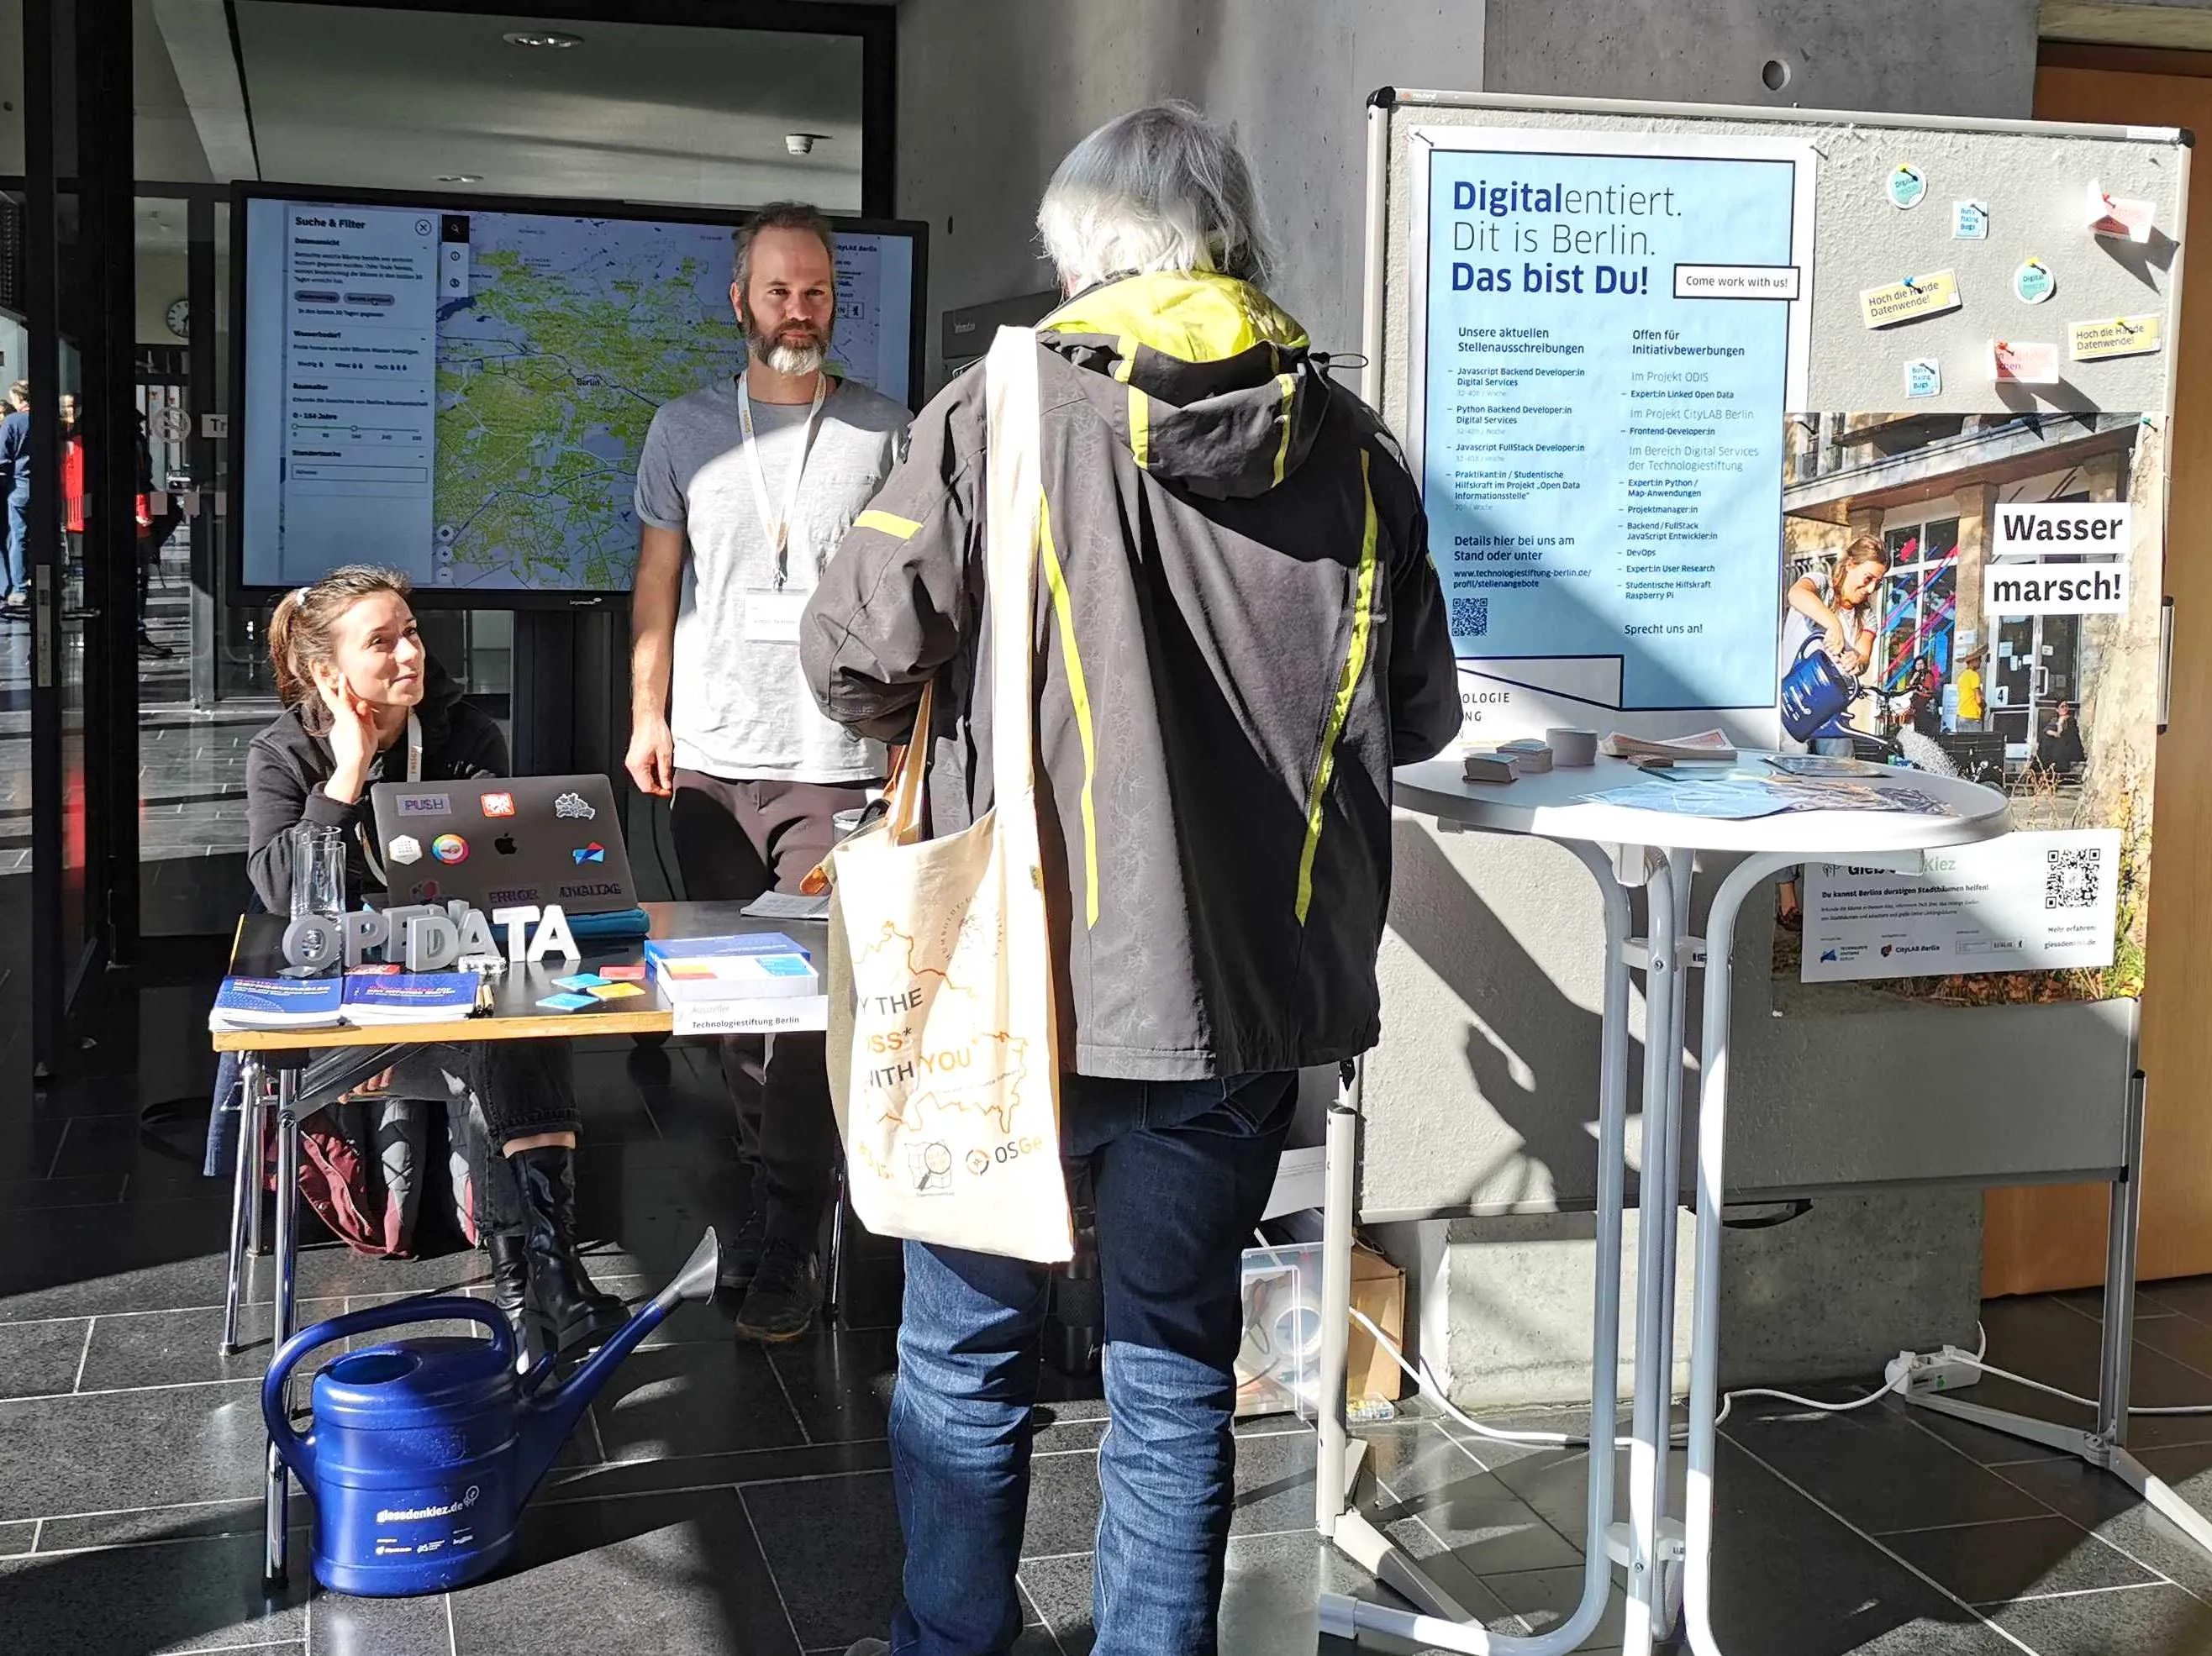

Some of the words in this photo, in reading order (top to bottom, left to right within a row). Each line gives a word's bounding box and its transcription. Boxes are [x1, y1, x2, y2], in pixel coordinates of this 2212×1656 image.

[1453, 179, 1682, 218] Digitalentiert.
[295, 216, 327, 228] Suche
[329, 218, 337, 228] &
[339, 218, 366, 229] Filter
[1454, 220, 1500, 252] Dit
[1514, 221, 1539, 253] is
[1553, 223, 1656, 255] Berlin.
[1451, 261, 1512, 292] Das
[1523, 261, 1585, 294] bist
[1595, 265, 1648, 295] Du!
[1686, 276, 1715, 287] Come
[1718, 276, 1745, 287] work
[1747, 276, 1771, 287] with
[1772, 277, 1788, 288] us!
[1868, 293, 1893, 307] Hoch
[1893, 290, 1908, 301] die
[1909, 282, 1940, 296] Hnde
[1870, 294, 1930, 318] Datenwende!
[1458, 327, 1497, 338] Unsere
[1498, 328, 1550, 339] aktuellen
[1632, 329, 1662, 340] Offen
[1664, 329, 1680, 340] für
[2076, 329, 2099, 339] Hoch
[2101, 328, 2114, 337] die
[1458, 341, 1585, 355] Stellenausschreibungen
[2077, 336, 2135, 351] Datenwende!
[1632, 344, 1746, 358] Initiativbewerbungen
[1456, 368, 1498, 377] Javascript
[1500, 368, 1534, 376] Backend
[1535, 369, 1585, 377] Developer:in
[1631, 372, 1644, 381] Im
[1646, 372, 1682, 383] Projekt
[1684, 372, 1709, 382] ODIS
[576, 377, 601, 386] Berlin
[1456, 378, 1483, 387] Digital
[1667, 390, 1693, 398] Linked
[1694, 391, 1715, 399] Open
[1716, 391, 1735, 399] Data
[1456, 405, 1486, 415] Python
[1487, 405, 1521, 414] Backend
[1522, 406, 1572, 415] Developer:in
[1630, 408, 1643, 418] Im
[1646, 408, 1681, 420] Projekt
[1683, 409, 1723, 421] CityLAB
[1725, 409, 1754, 419] Berlin
[1456, 416, 1483, 425] Digital
[1484, 416, 1518, 424] Services
[1455, 444, 1498, 453] Javascript
[1498, 444, 1534, 452] FullStack
[1535, 444, 1585, 453] Developer:in
[1629, 446, 1641, 455] Im
[1645, 445, 1682, 456] Bereich
[1684, 446, 1716, 458] Digital
[1719, 446, 1759, 457] Services
[1629, 460, 1645, 471] der
[1648, 460, 1743, 472] Technologiestiftung
[1514, 471, 1564, 479] Studentische
[1455, 481, 1493, 490] Hilfskraft
[1506, 481, 1535, 491] Projekt
[1665, 479, 1693, 487] Python
[1628, 490, 1702, 498] Map-Anwendungen
[1627, 506, 1698, 514] Projektmanager:in
[2003, 514, 2123, 541] Wasser
[1454, 535, 1492, 546] Details
[1493, 536, 1515, 546] hier
[1518, 535, 1535, 546] bei
[1537, 538, 1556, 546] uns
[1626, 533, 1667, 541] JavaScript
[1454, 550, 1484, 561] Stand
[1486, 550, 1512, 561] oder
[1514, 551, 1543, 561] unter
[1626, 549, 1656, 557] DevOps
[1452, 569, 1592, 579] www.technologiestiftung-berlin.de/
[1453, 580, 1540, 590] profil/stellenangebote
[1675, 581, 1712, 589] Hilfskraft
[1993, 570, 2121, 602] marsch!
[1625, 591, 1665, 601] Raspberry
[1624, 623, 1664, 636] Sprecht
[1666, 625, 1684, 634] uns
[1687, 623, 1704, 633] an!
[1997, 689, 2004, 703] 4
[404, 798, 444, 812] PUSH
[1923, 855, 1957, 873] Kiez
[1821, 891, 1832, 899] Du
[1833, 889, 1857, 898] kannst
[1858, 889, 1883, 897] Berlins
[1883, 886, 1917, 896] durstigen
[1965, 883, 1989, 891] helfen!
[2047, 925, 2065, 933] Mehr
[406, 905, 582, 972] DATA
[875, 988, 924, 1015] THE
[692, 1017, 773, 1030] Technologiestiftung
[775, 1016, 799, 1026] Berlin
[919, 1047, 972, 1075] YOU
[376, 1501, 464, 1524] giessdenkiez.de
